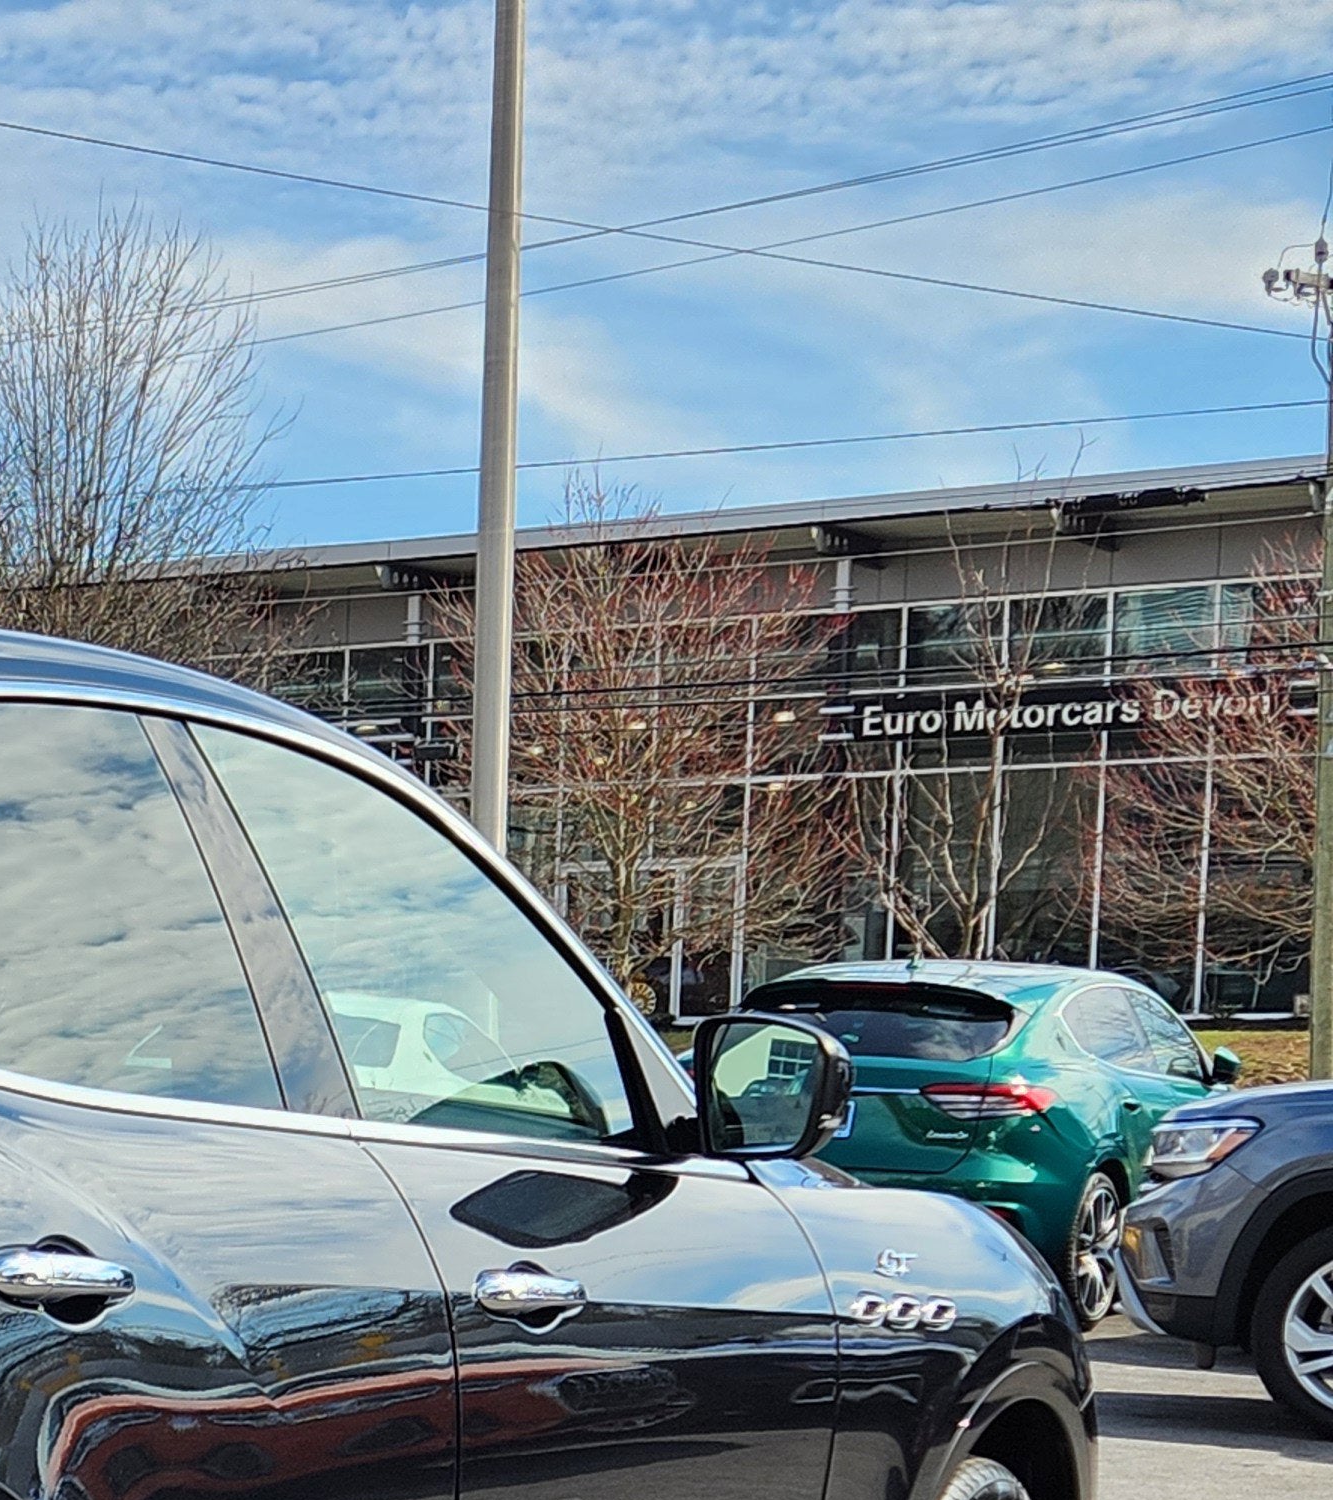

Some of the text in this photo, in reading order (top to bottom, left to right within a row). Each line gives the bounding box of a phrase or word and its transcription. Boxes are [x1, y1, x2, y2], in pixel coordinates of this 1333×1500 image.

[862, 705, 942, 736] Euro
[953, 700, 1140, 732] Motorcars
[875, 1249, 918, 1277] GT
